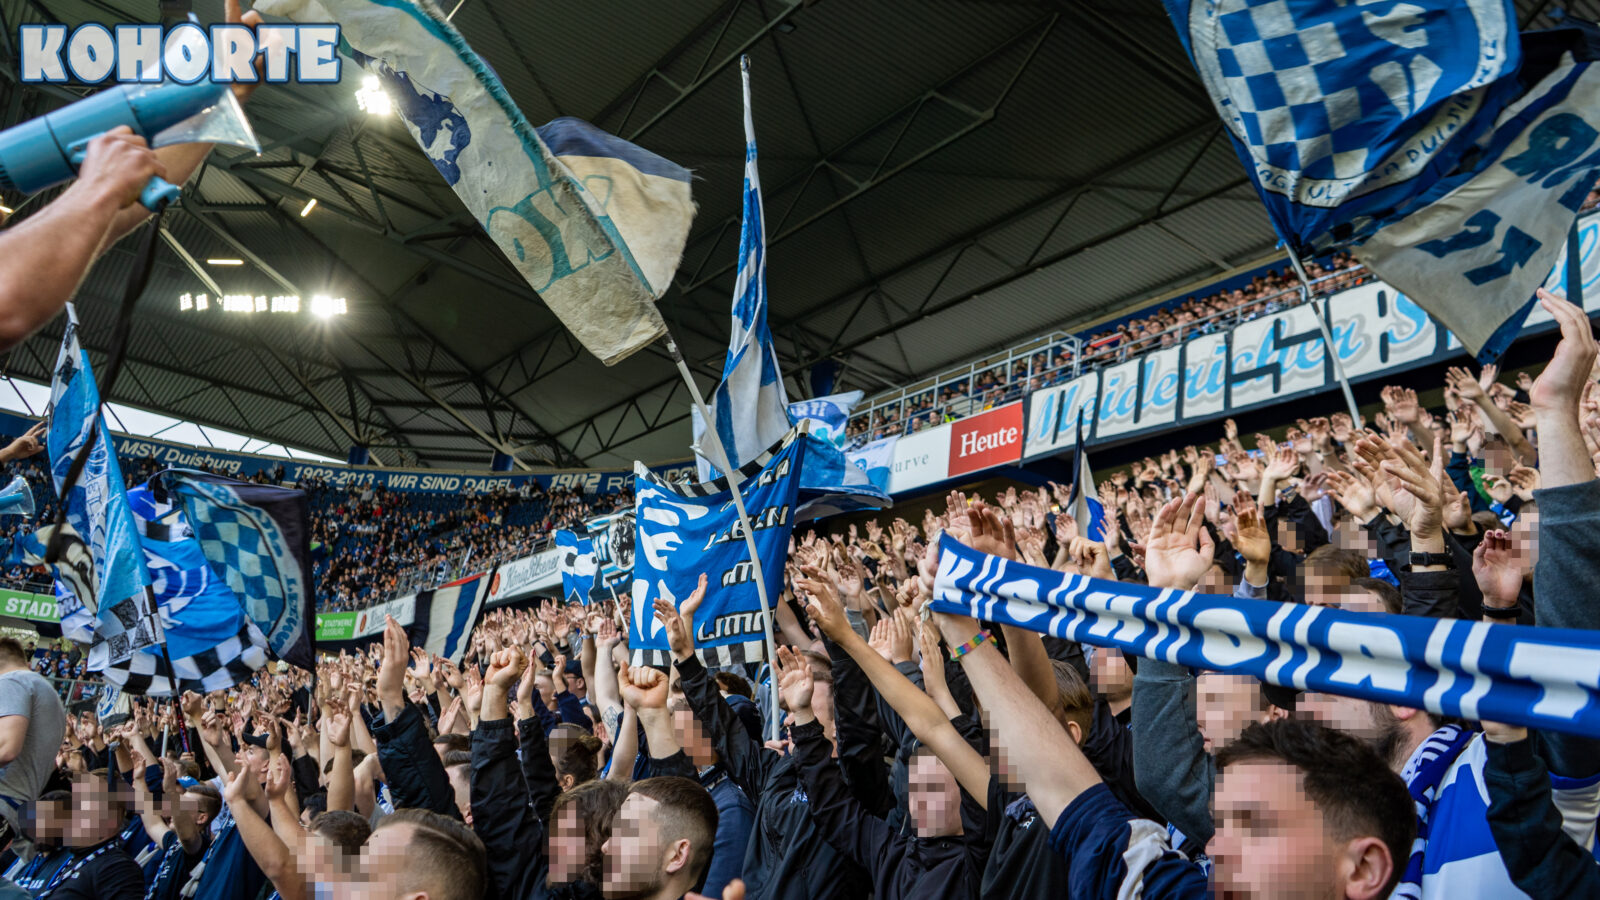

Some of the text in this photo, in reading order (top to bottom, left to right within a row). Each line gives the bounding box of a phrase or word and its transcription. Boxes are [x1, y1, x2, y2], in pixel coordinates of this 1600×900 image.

[959, 426, 1018, 458] Heute
[119, 440, 242, 474] MSV Duisburg
[890, 452, 929, 474] urve
[387, 474, 417, 489] WIR
[419, 476, 460, 491] SIND
[5, 597, 60, 618] STADT
